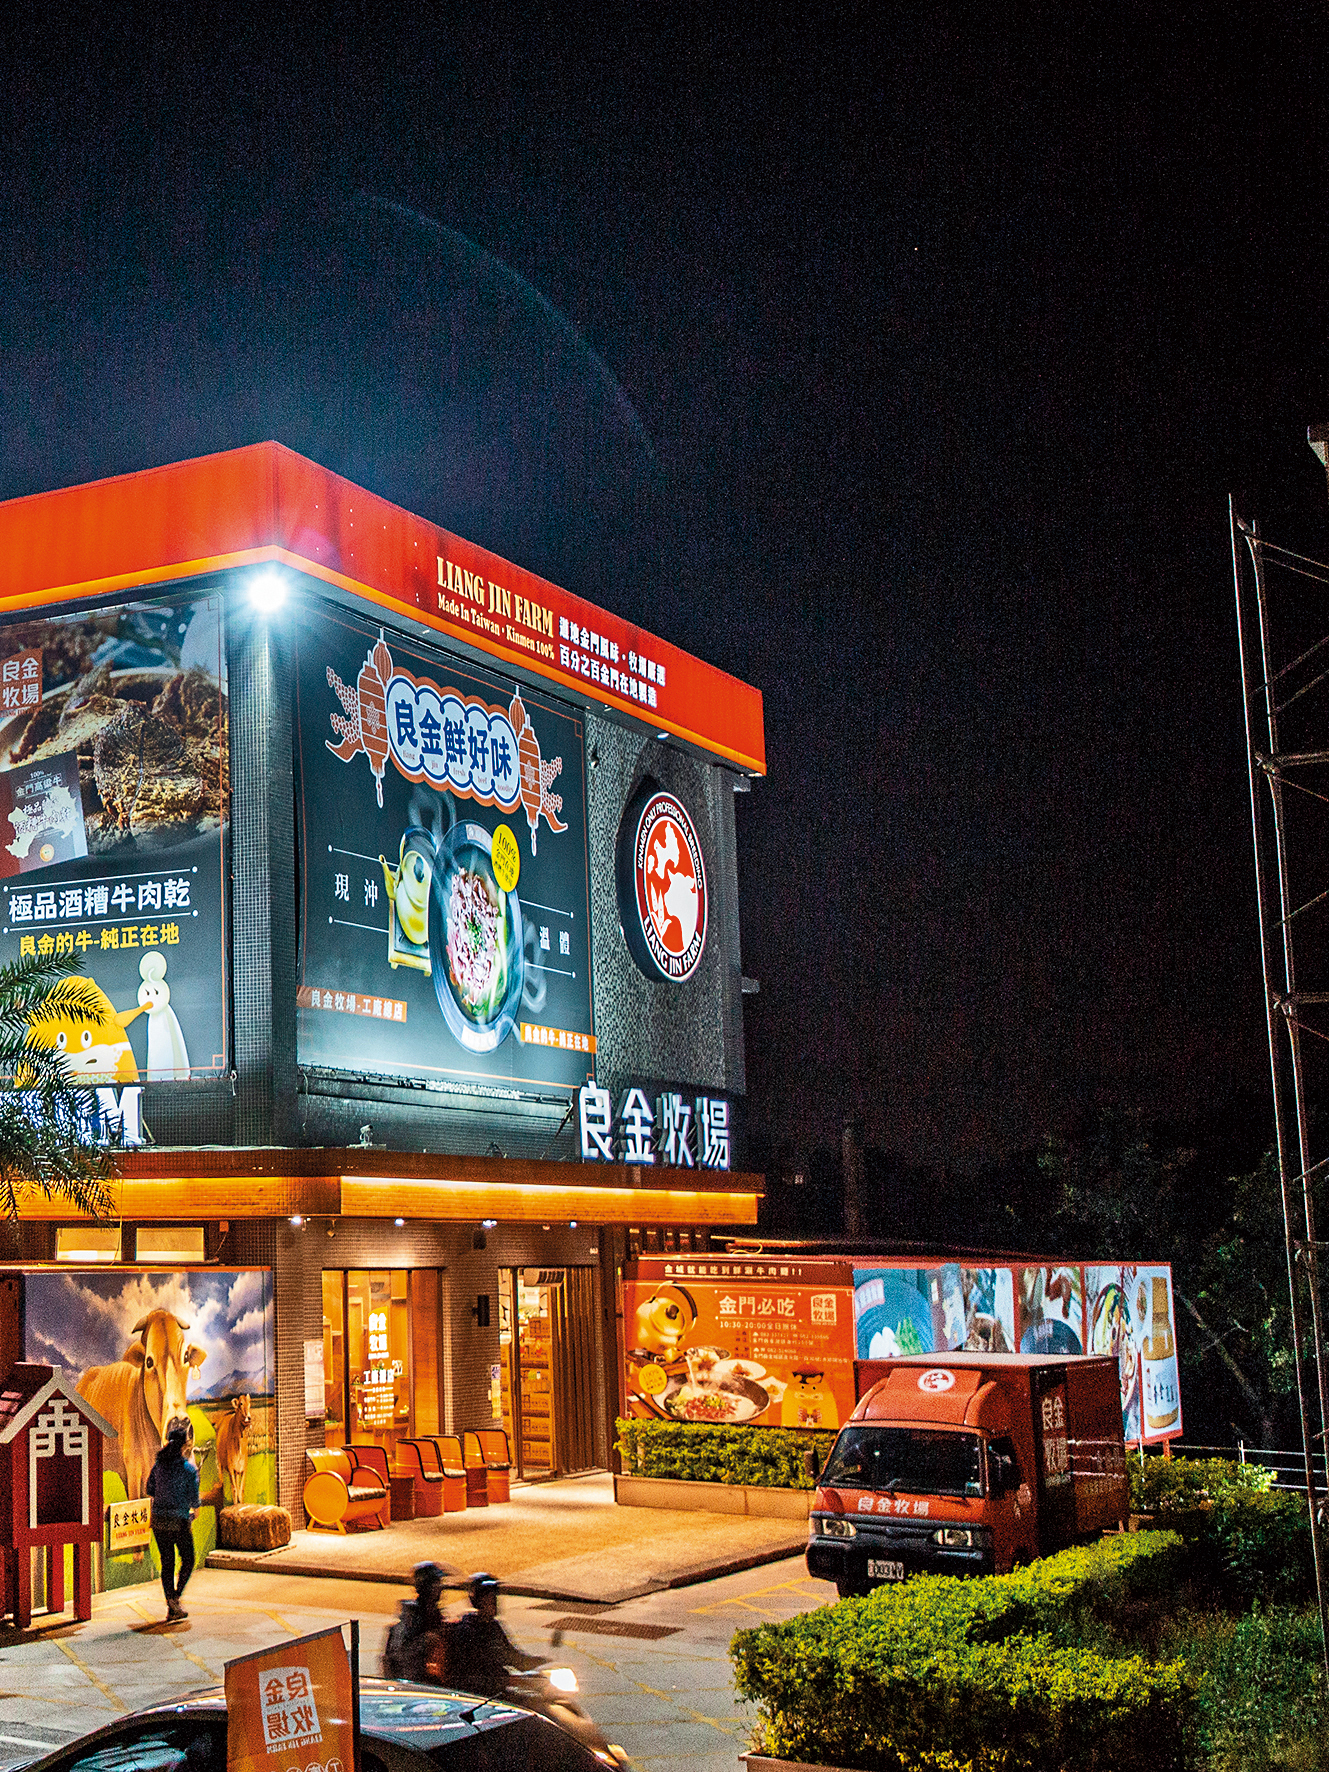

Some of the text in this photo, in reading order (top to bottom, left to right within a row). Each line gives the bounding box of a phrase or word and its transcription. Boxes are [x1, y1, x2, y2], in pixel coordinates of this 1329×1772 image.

[436, 556, 554, 638] LIANG JIN FARM
[437, 592, 555, 660] Made In Taiwan Kinmen 100%
[2, 657, 39, 683] 良金
[2, 683, 39, 708] 牧場
[395, 698, 512, 781] 良金鮮好味
[499, 832, 517, 863] 100%
[637, 801, 703, 890] KINMEN ONLY PROFESSIONAL BREEDING
[9, 878, 190, 923] 極品酒糟牛肉乾
[643, 916, 702, 975] LIANG JIN FARM
[579, 1080, 731, 1170] 良金牧場
[718, 1295, 795, 1317] 金門必吃
[113, 1507, 148, 1529] 良金牧場
[858, 1496, 929, 1516] 良金牧場
